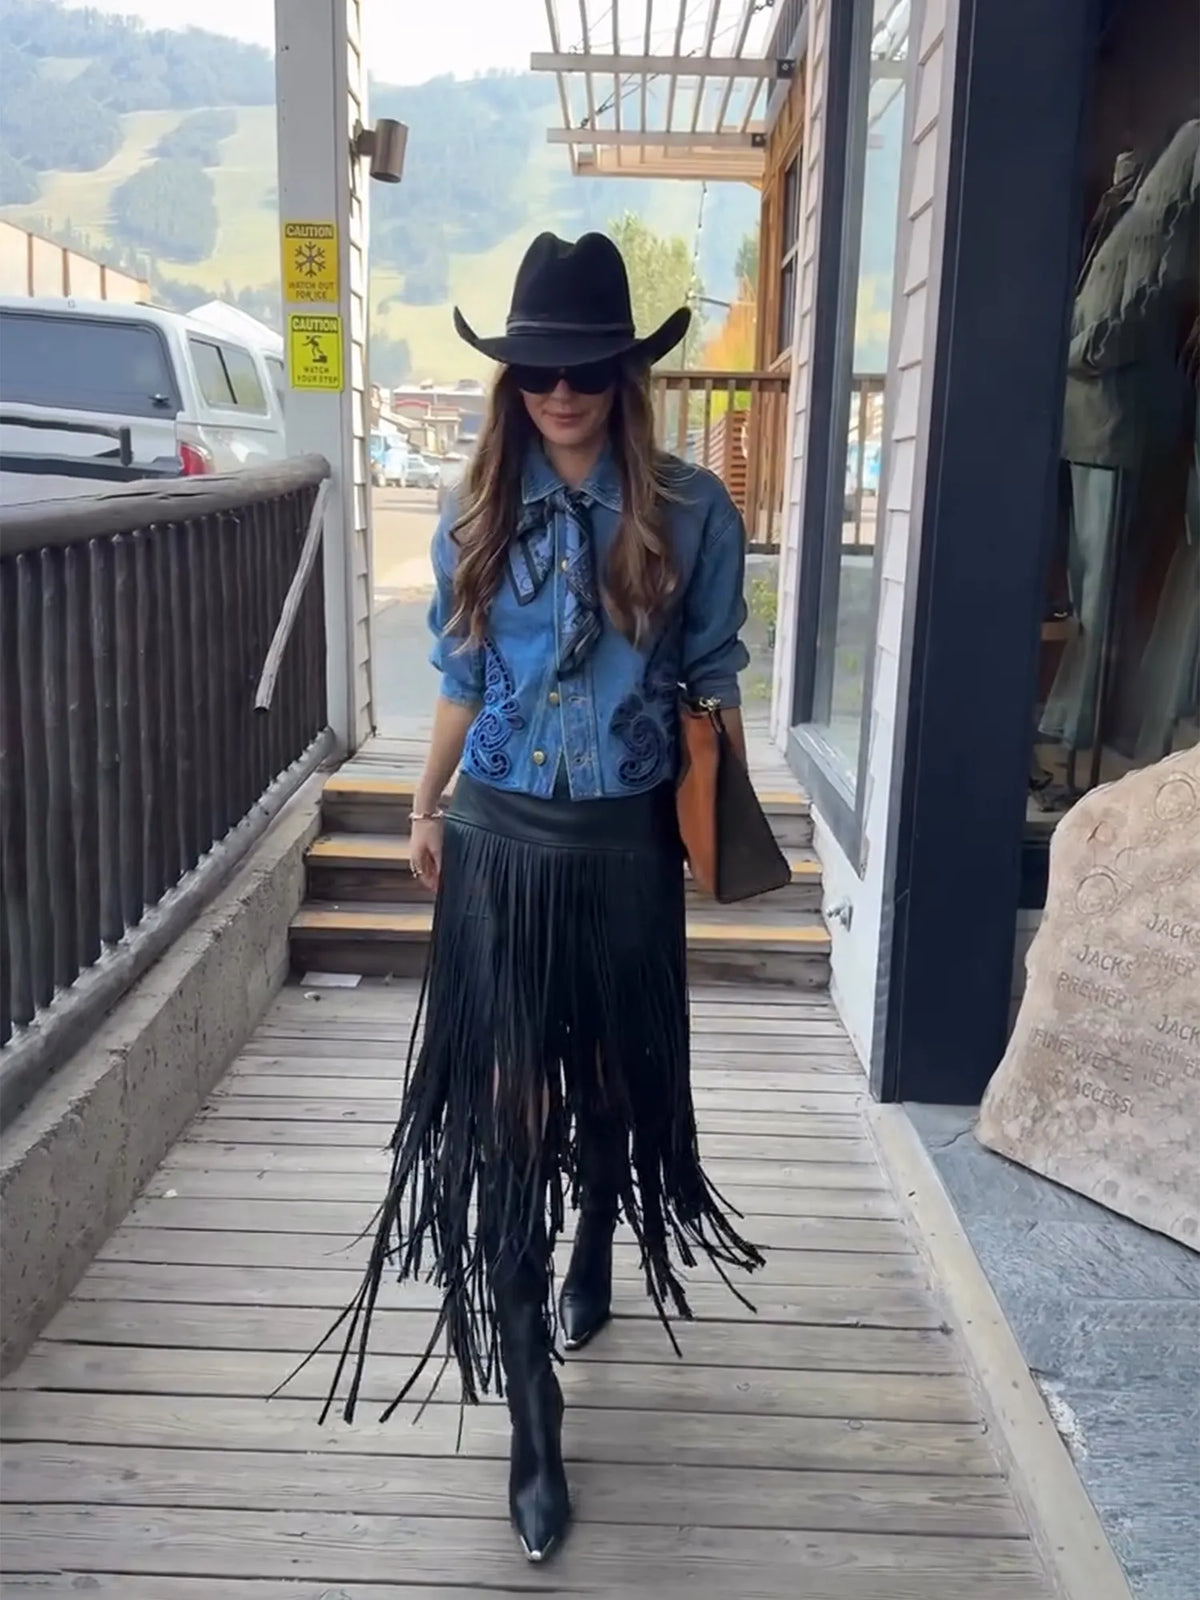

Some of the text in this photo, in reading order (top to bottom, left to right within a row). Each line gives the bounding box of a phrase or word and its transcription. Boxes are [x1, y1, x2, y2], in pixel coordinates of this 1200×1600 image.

[287, 225, 333, 237] CAUTION
[318, 281, 334, 290] OUT
[313, 291, 327, 300] ICE
[292, 318, 338, 331] CAUTION
[1077, 944, 1134, 979] JACKS
[1056, 971, 1127, 1010] PREMIER
